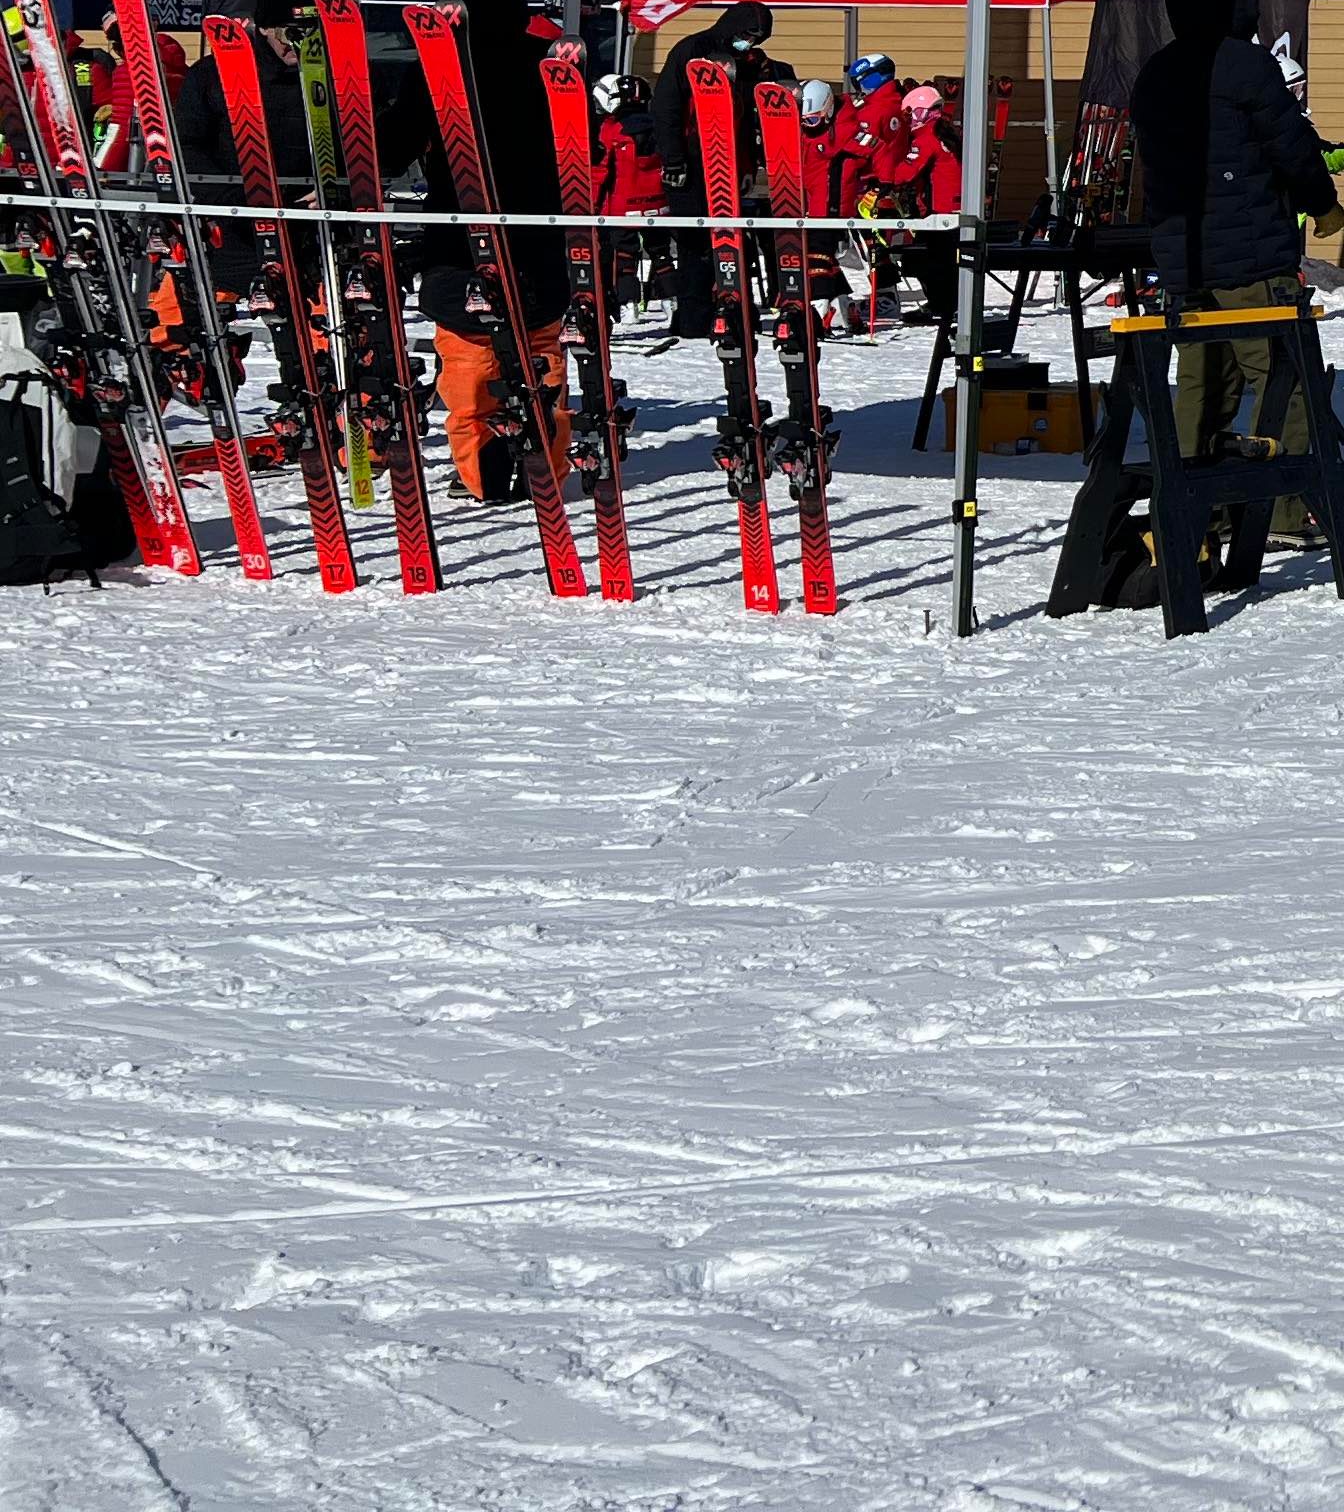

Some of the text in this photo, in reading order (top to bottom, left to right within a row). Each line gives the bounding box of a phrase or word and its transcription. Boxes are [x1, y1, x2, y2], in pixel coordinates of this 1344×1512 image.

[243, 553, 266, 570] 30
[325, 564, 345, 582] 17
[407, 566, 426, 584] 18
[557, 568, 577, 586] 18
[606, 579, 625, 595] 17
[751, 585, 770, 601] 14
[809, 580, 829, 597] 15
